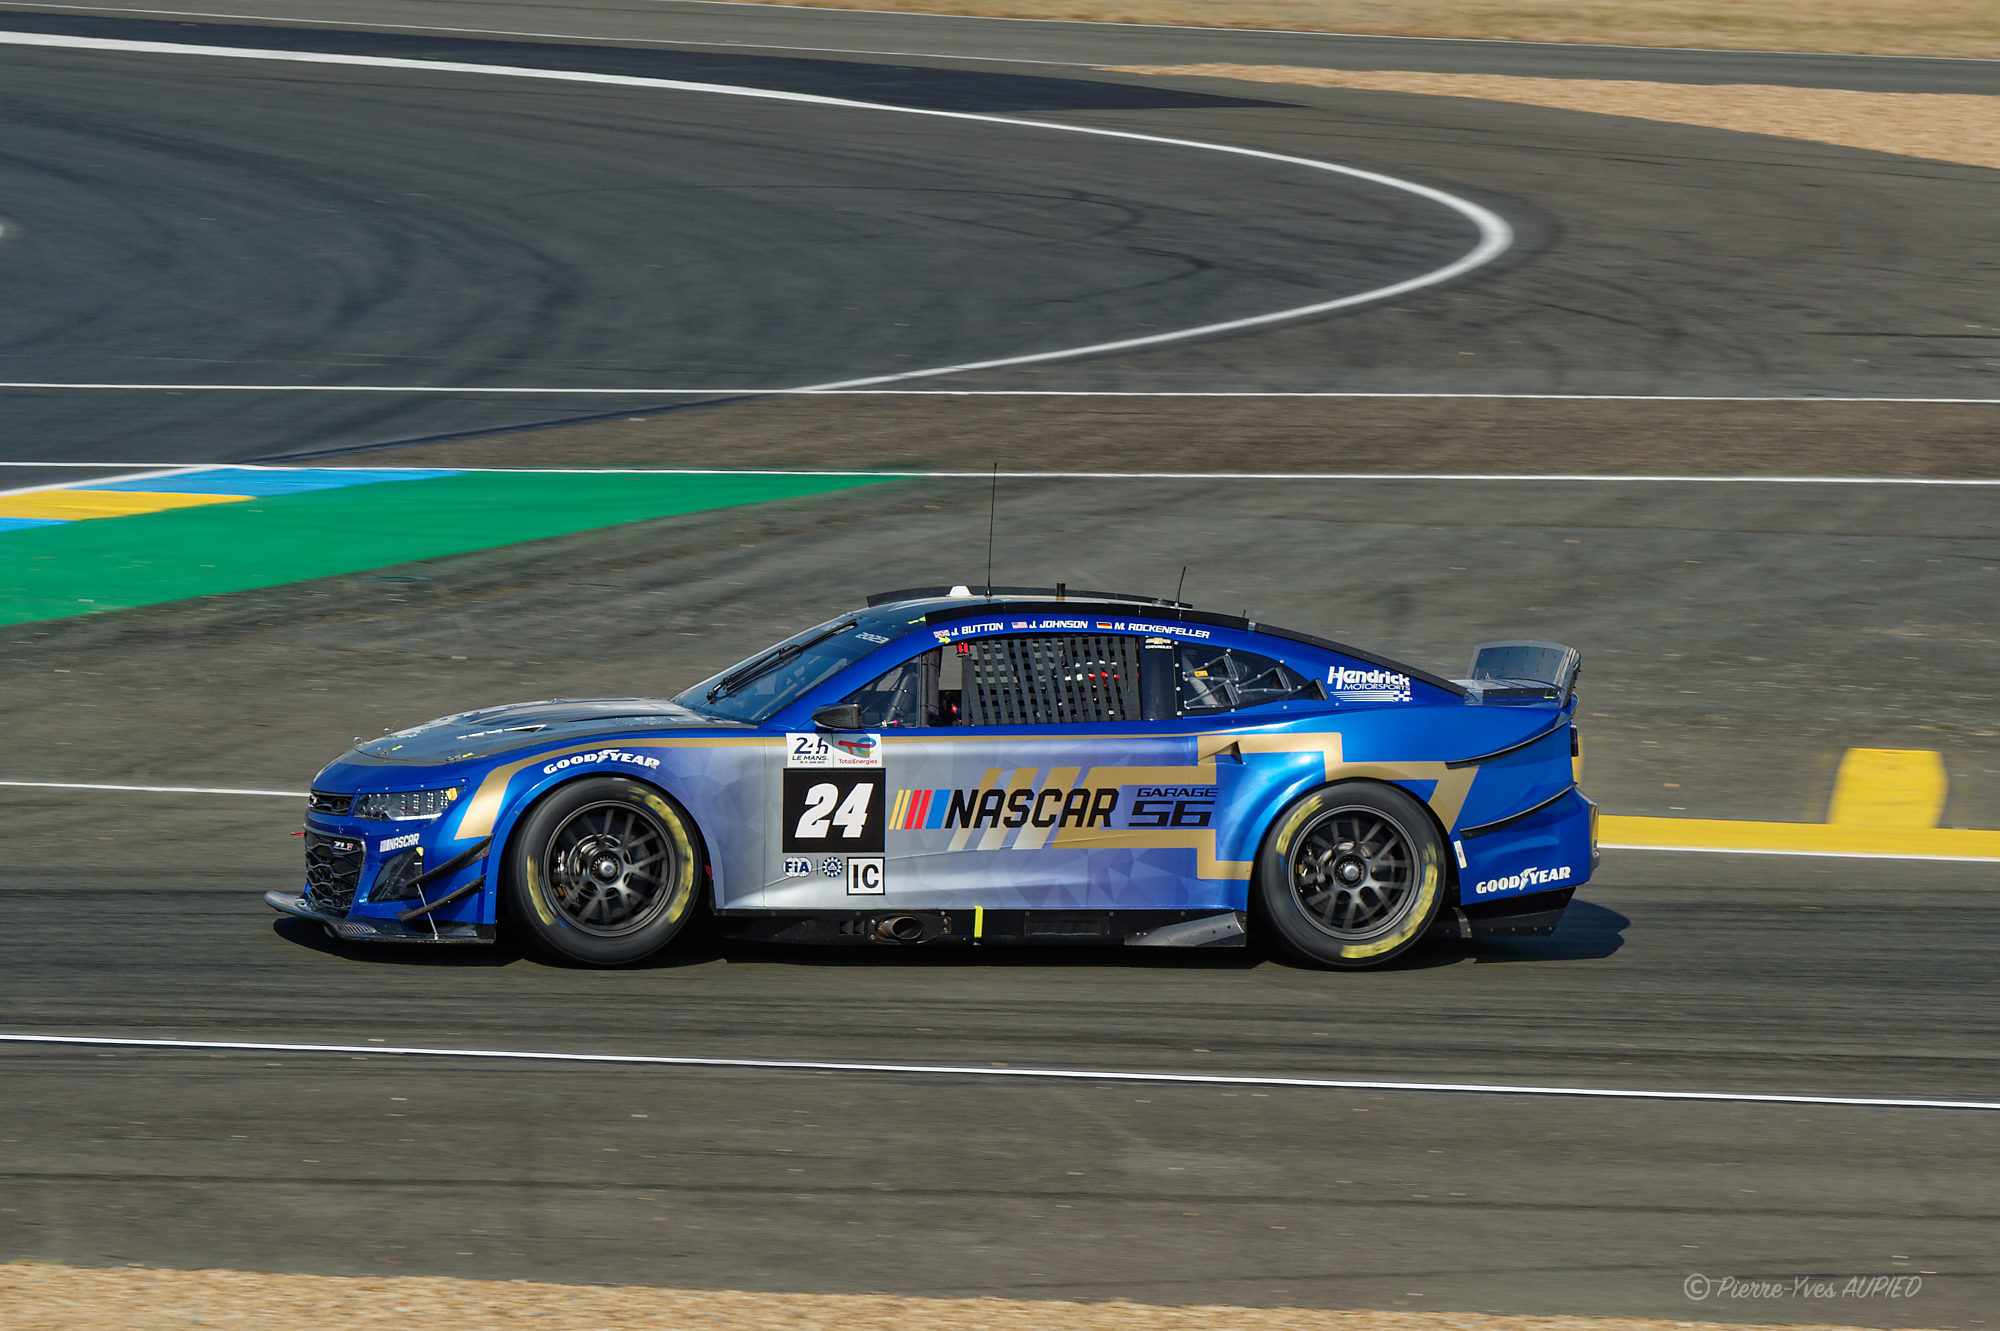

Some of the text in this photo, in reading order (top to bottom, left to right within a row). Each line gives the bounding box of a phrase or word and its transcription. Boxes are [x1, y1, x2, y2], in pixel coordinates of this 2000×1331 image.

[951, 622, 1004, 636] J. BUTTON
[1029, 620, 1088, 629] J. JOHNSON
[1114, 622, 1211, 639] M. ROCKENFELLER
[855, 631, 890, 644] 2023
[1327, 666, 1410, 690] Hendrick
[1343, 683, 1411, 691] MOTORSPORTS
[543, 749, 661, 775] GOODYEAR
[1136, 787, 1220, 798] GARAGE
[794, 783, 874, 838] 24
[944, 788, 1120, 829] NASCAR
[1128, 800, 1216, 828] 56
[387, 833, 420, 851] NASCAR
[853, 864, 879, 889] IC
[1475, 866, 1571, 894] GOODYEAR
